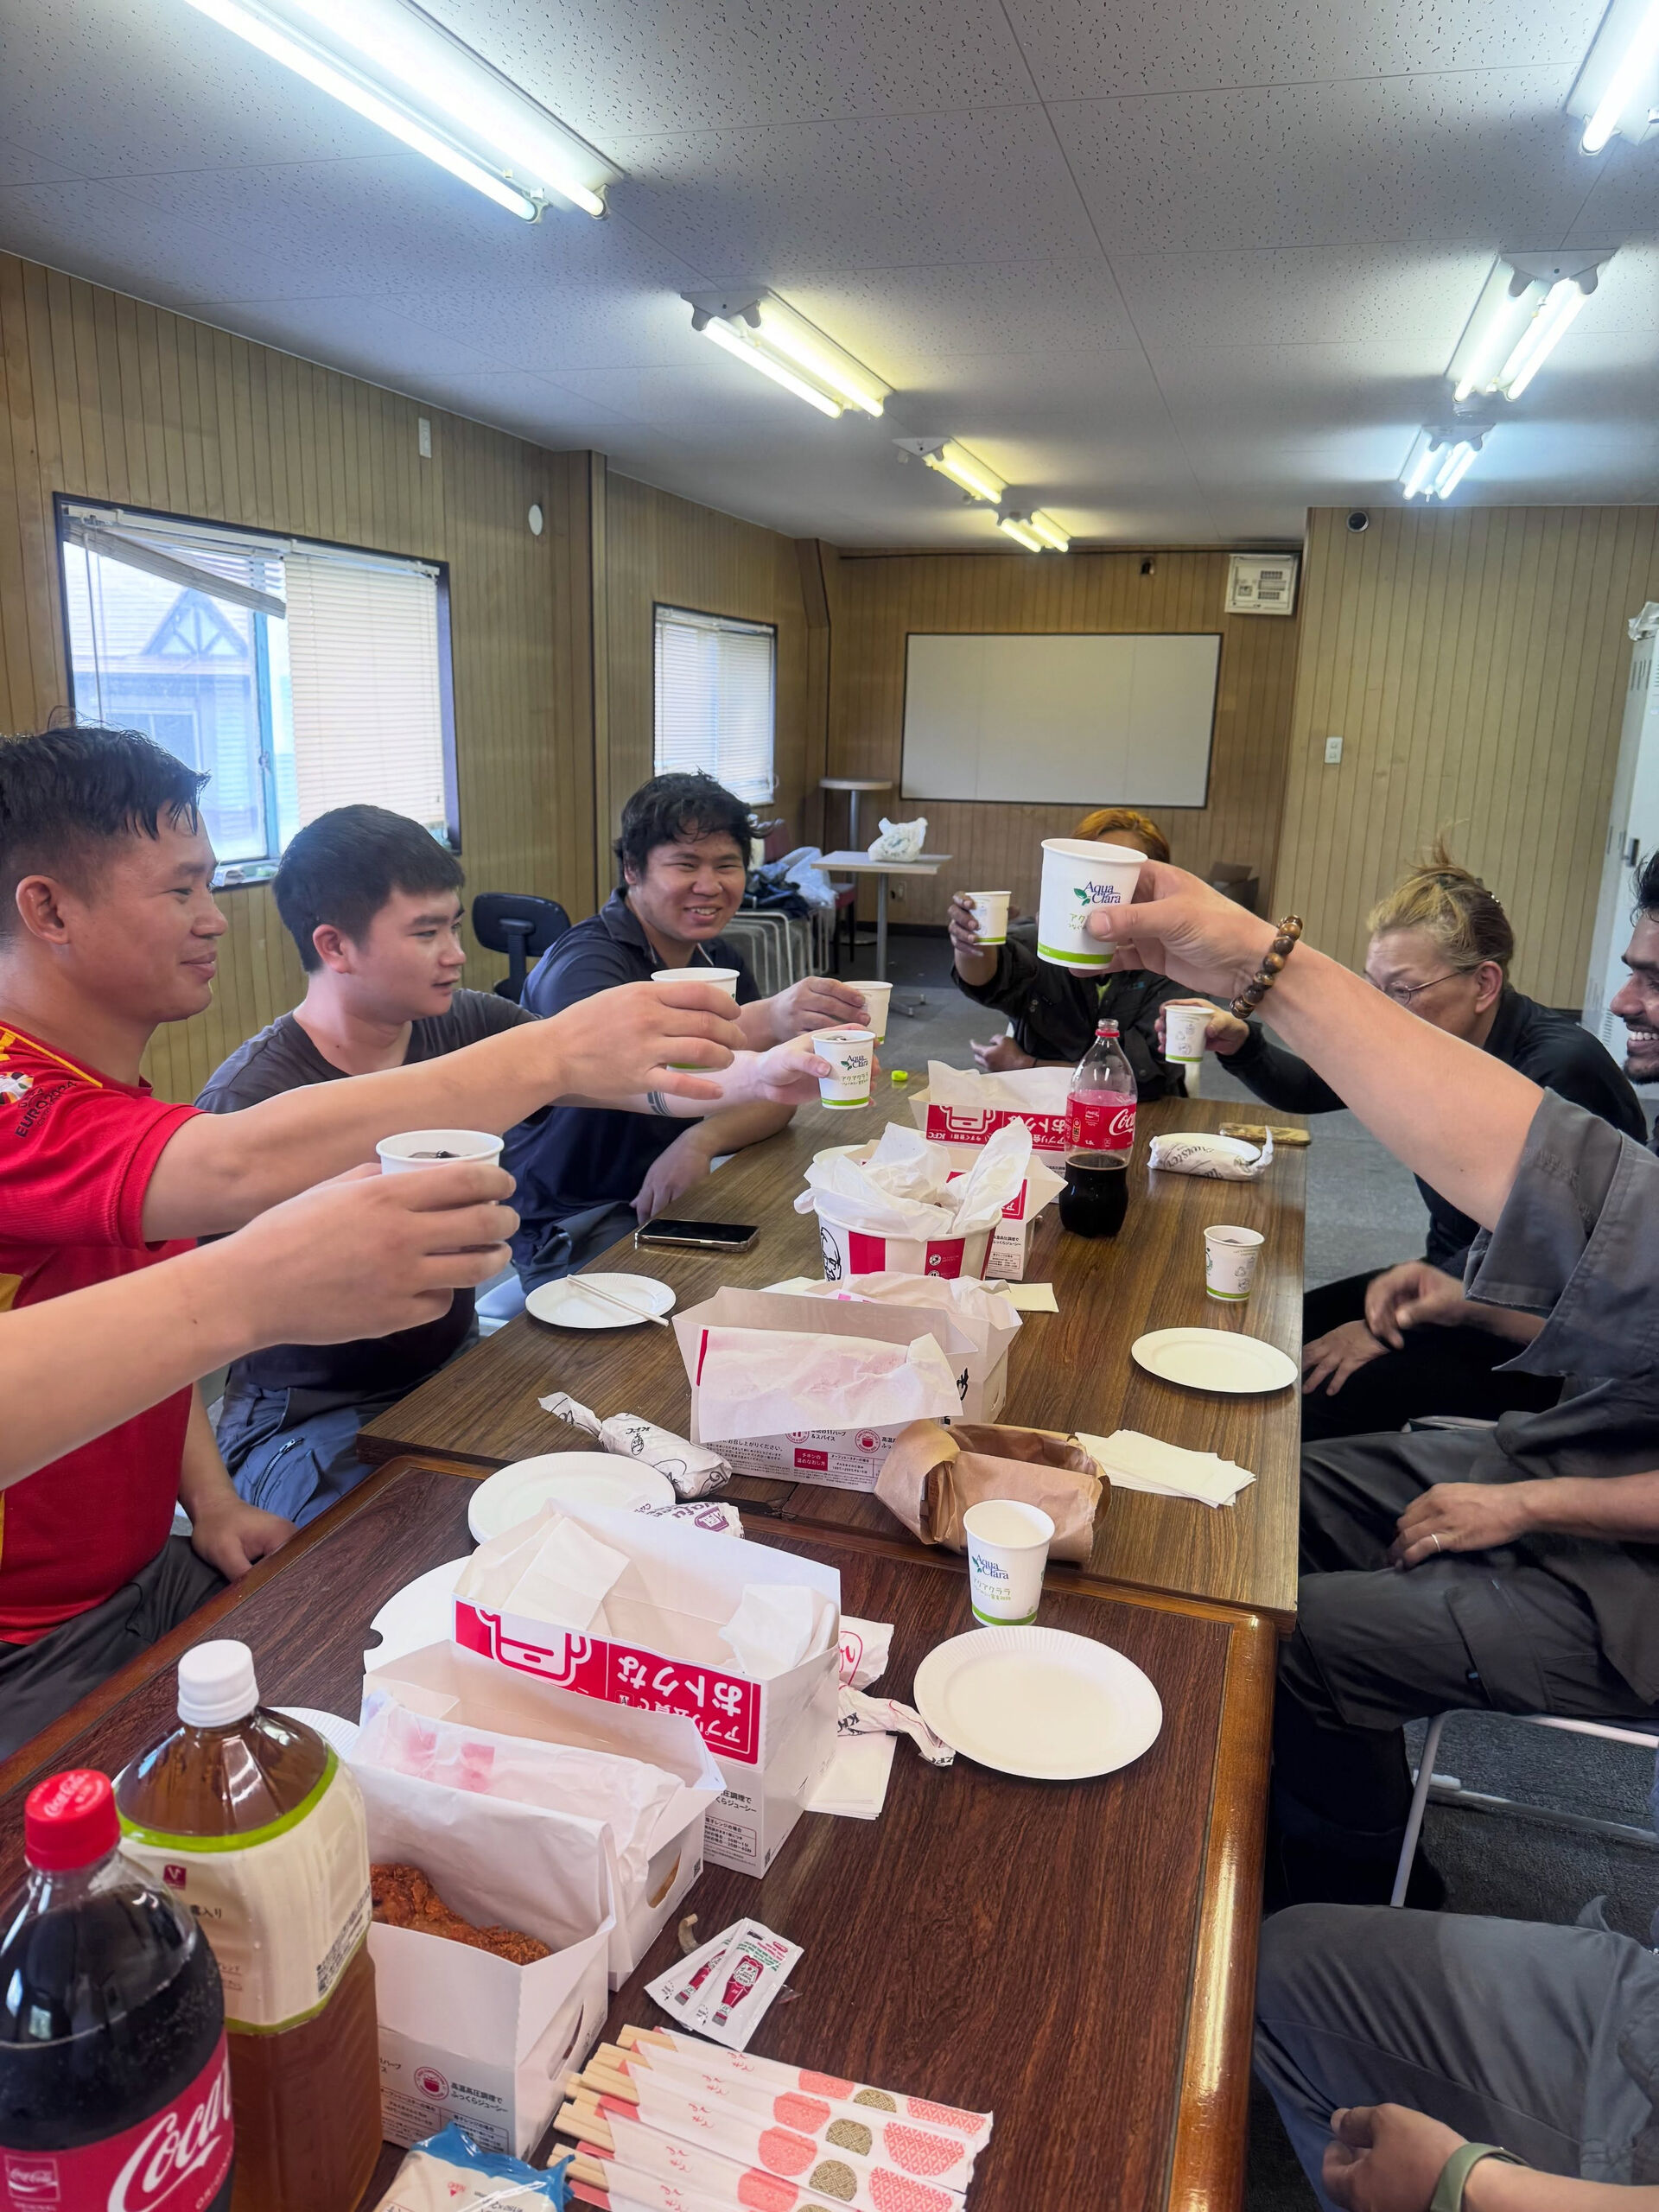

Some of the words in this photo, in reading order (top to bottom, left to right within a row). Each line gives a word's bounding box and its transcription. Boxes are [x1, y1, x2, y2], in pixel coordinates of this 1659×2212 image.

[1084, 880, 1114, 896] Aqua
[1091, 893, 1121, 904] Clara
[852, 1059, 868, 1069] Clara
[927, 1131, 946, 1141] KFC
[625, 1426, 652, 1435] KFC
[976, 1554, 999, 1570] Aqua
[982, 1566, 1009, 1580] Clara
[616, 1656, 743, 1717] おトクな
[721, 1789, 752, 1804] 圧調理で
